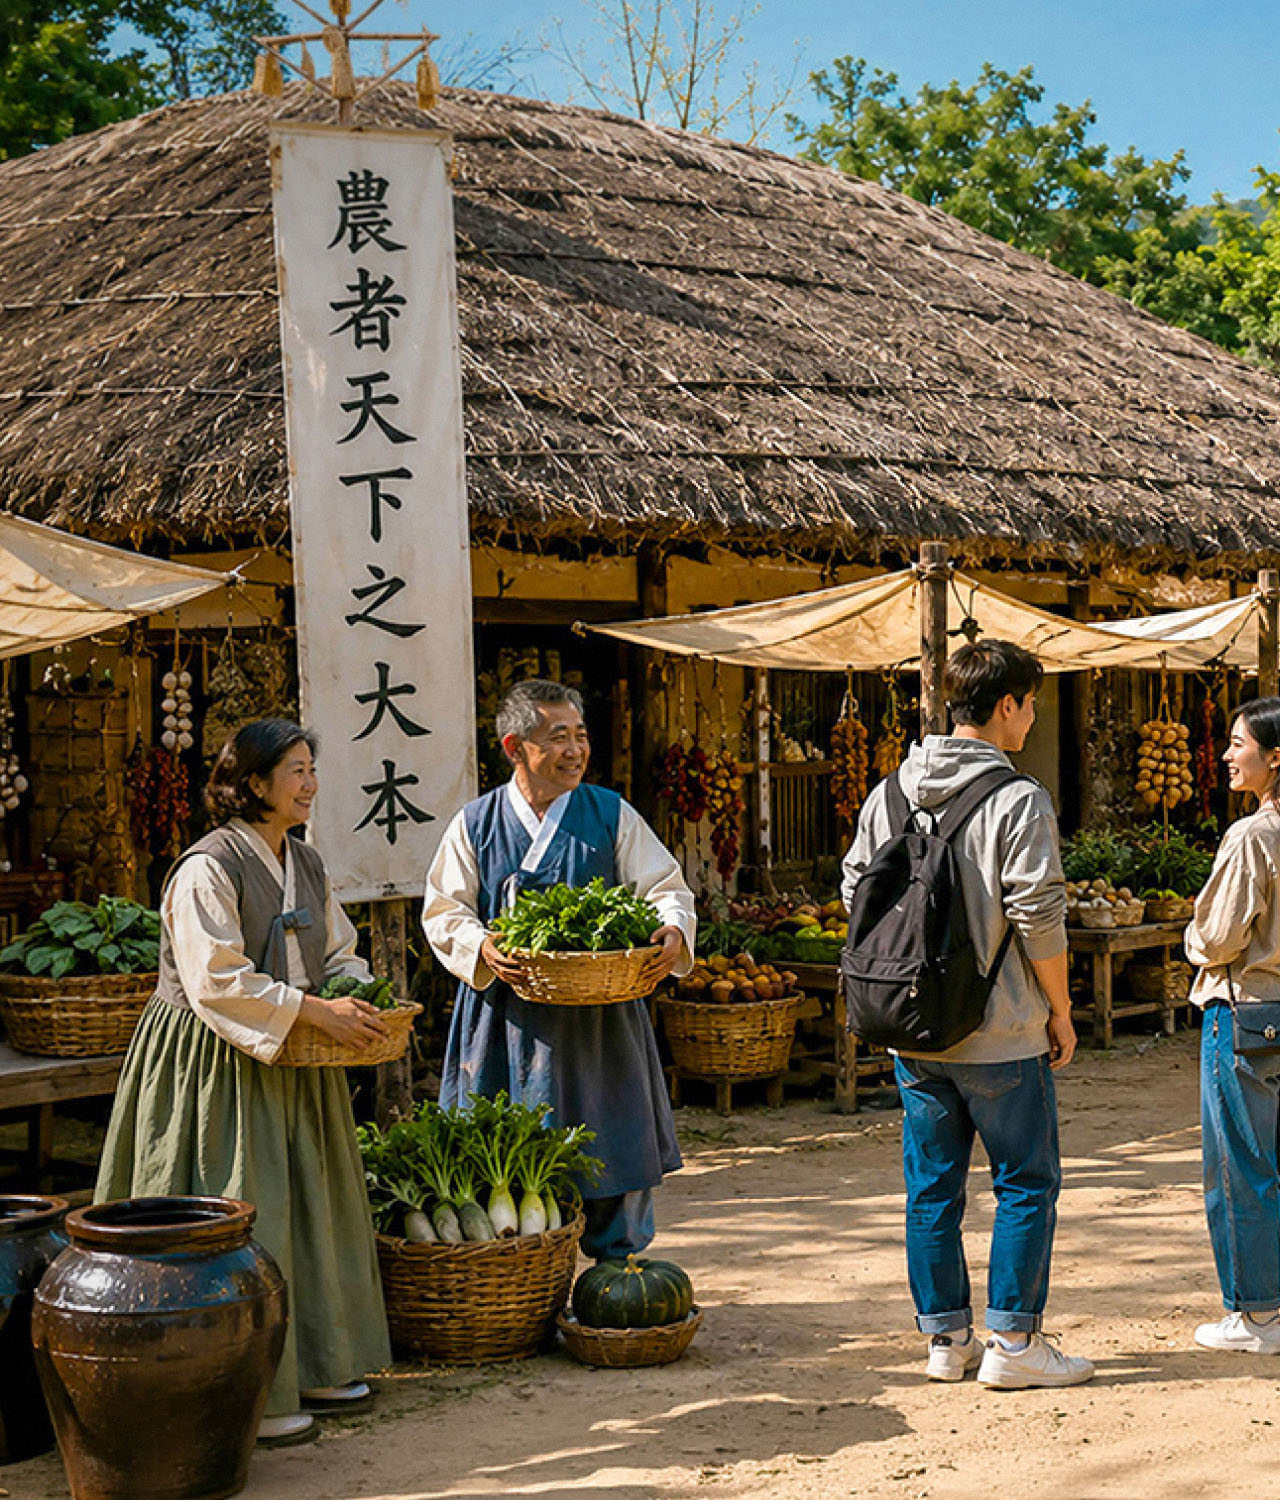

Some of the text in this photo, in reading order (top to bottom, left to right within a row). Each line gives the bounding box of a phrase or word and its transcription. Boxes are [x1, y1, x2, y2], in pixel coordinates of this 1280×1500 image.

[327, 168, 436, 846] 農者天下之大本
